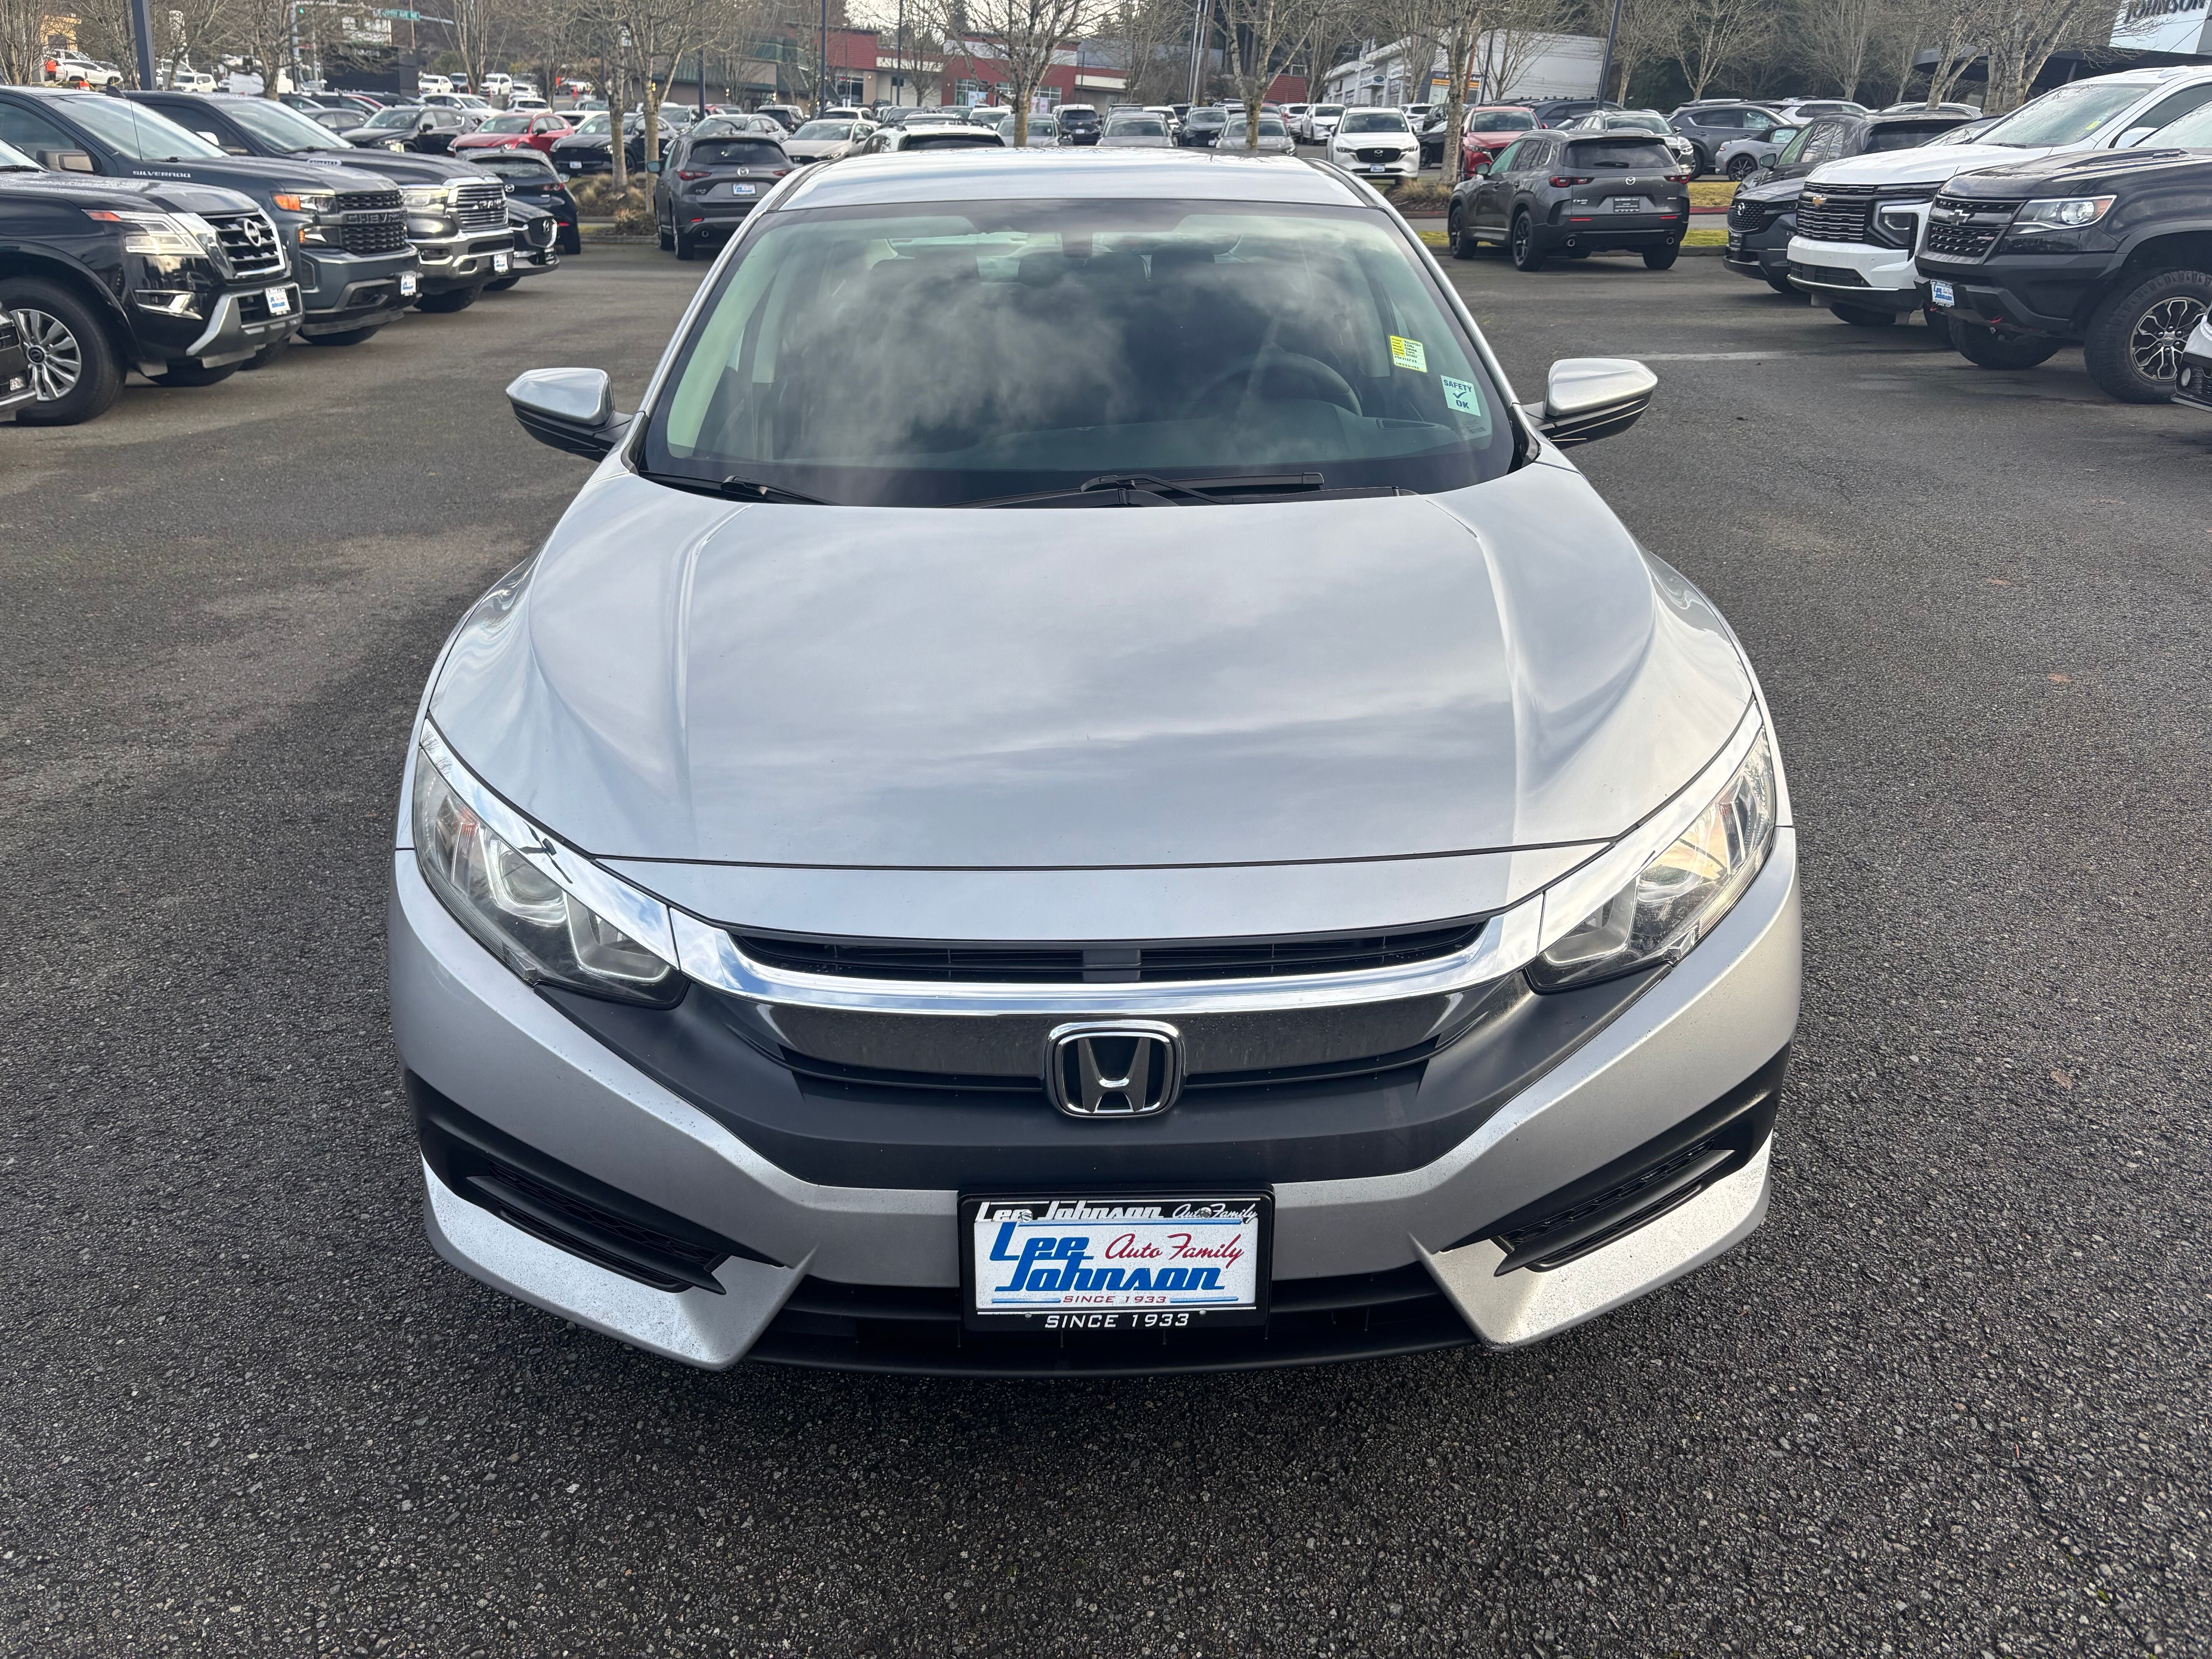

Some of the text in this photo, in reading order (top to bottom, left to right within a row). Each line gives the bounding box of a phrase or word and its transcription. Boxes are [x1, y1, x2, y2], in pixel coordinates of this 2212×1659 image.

[1443, 380, 1472, 392] SAFETY
[1456, 400, 1470, 409] OK
[975, 1200, 1258, 1224] Lee Johnson Aut Family
[989, 1221, 1245, 1269] Lee Auto Family
[994, 1257, 1225, 1291] Johnson
[1063, 1295, 1116, 1304] SINCE
[1044, 1313, 1189, 1328] SINCE 1933
